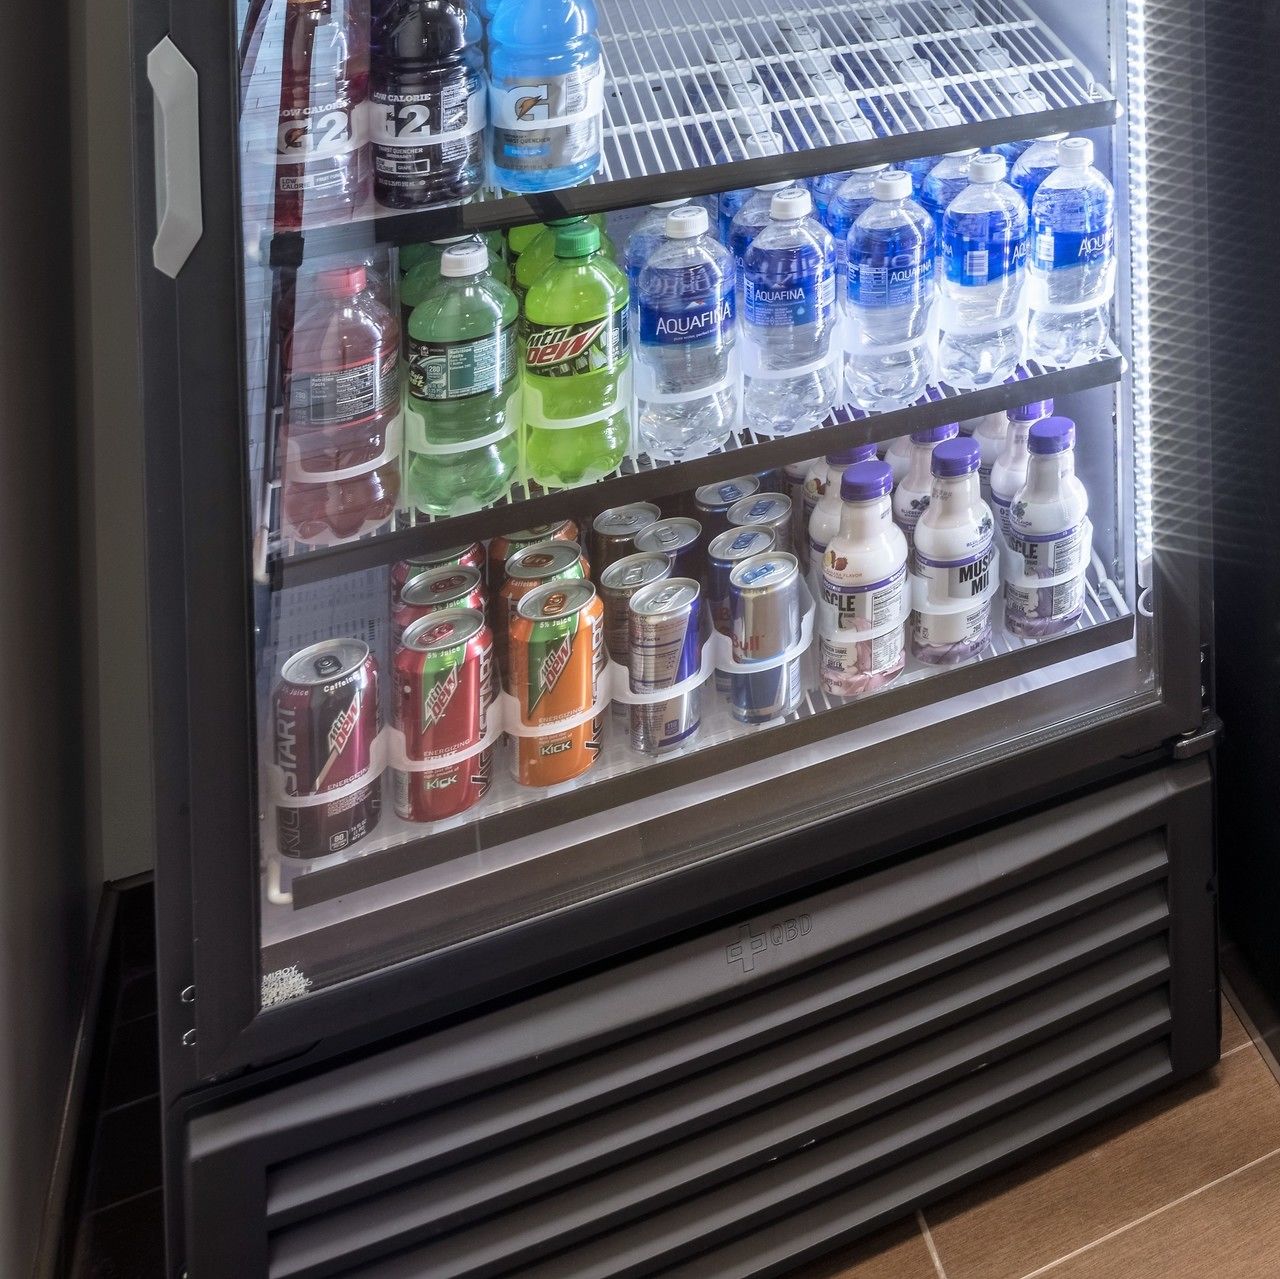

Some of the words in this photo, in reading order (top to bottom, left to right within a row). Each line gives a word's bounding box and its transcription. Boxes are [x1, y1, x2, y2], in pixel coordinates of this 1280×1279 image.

[388, 92, 431, 103] CALORIE
[506, 84, 551, 122] G
[754, 287, 806, 302] AQUAFINA
[655, 301, 732, 336] AQUAFINA
[552, 616, 572, 627] Juice
[541, 740, 573, 756] KICK
[426, 774, 458, 790] KICK
